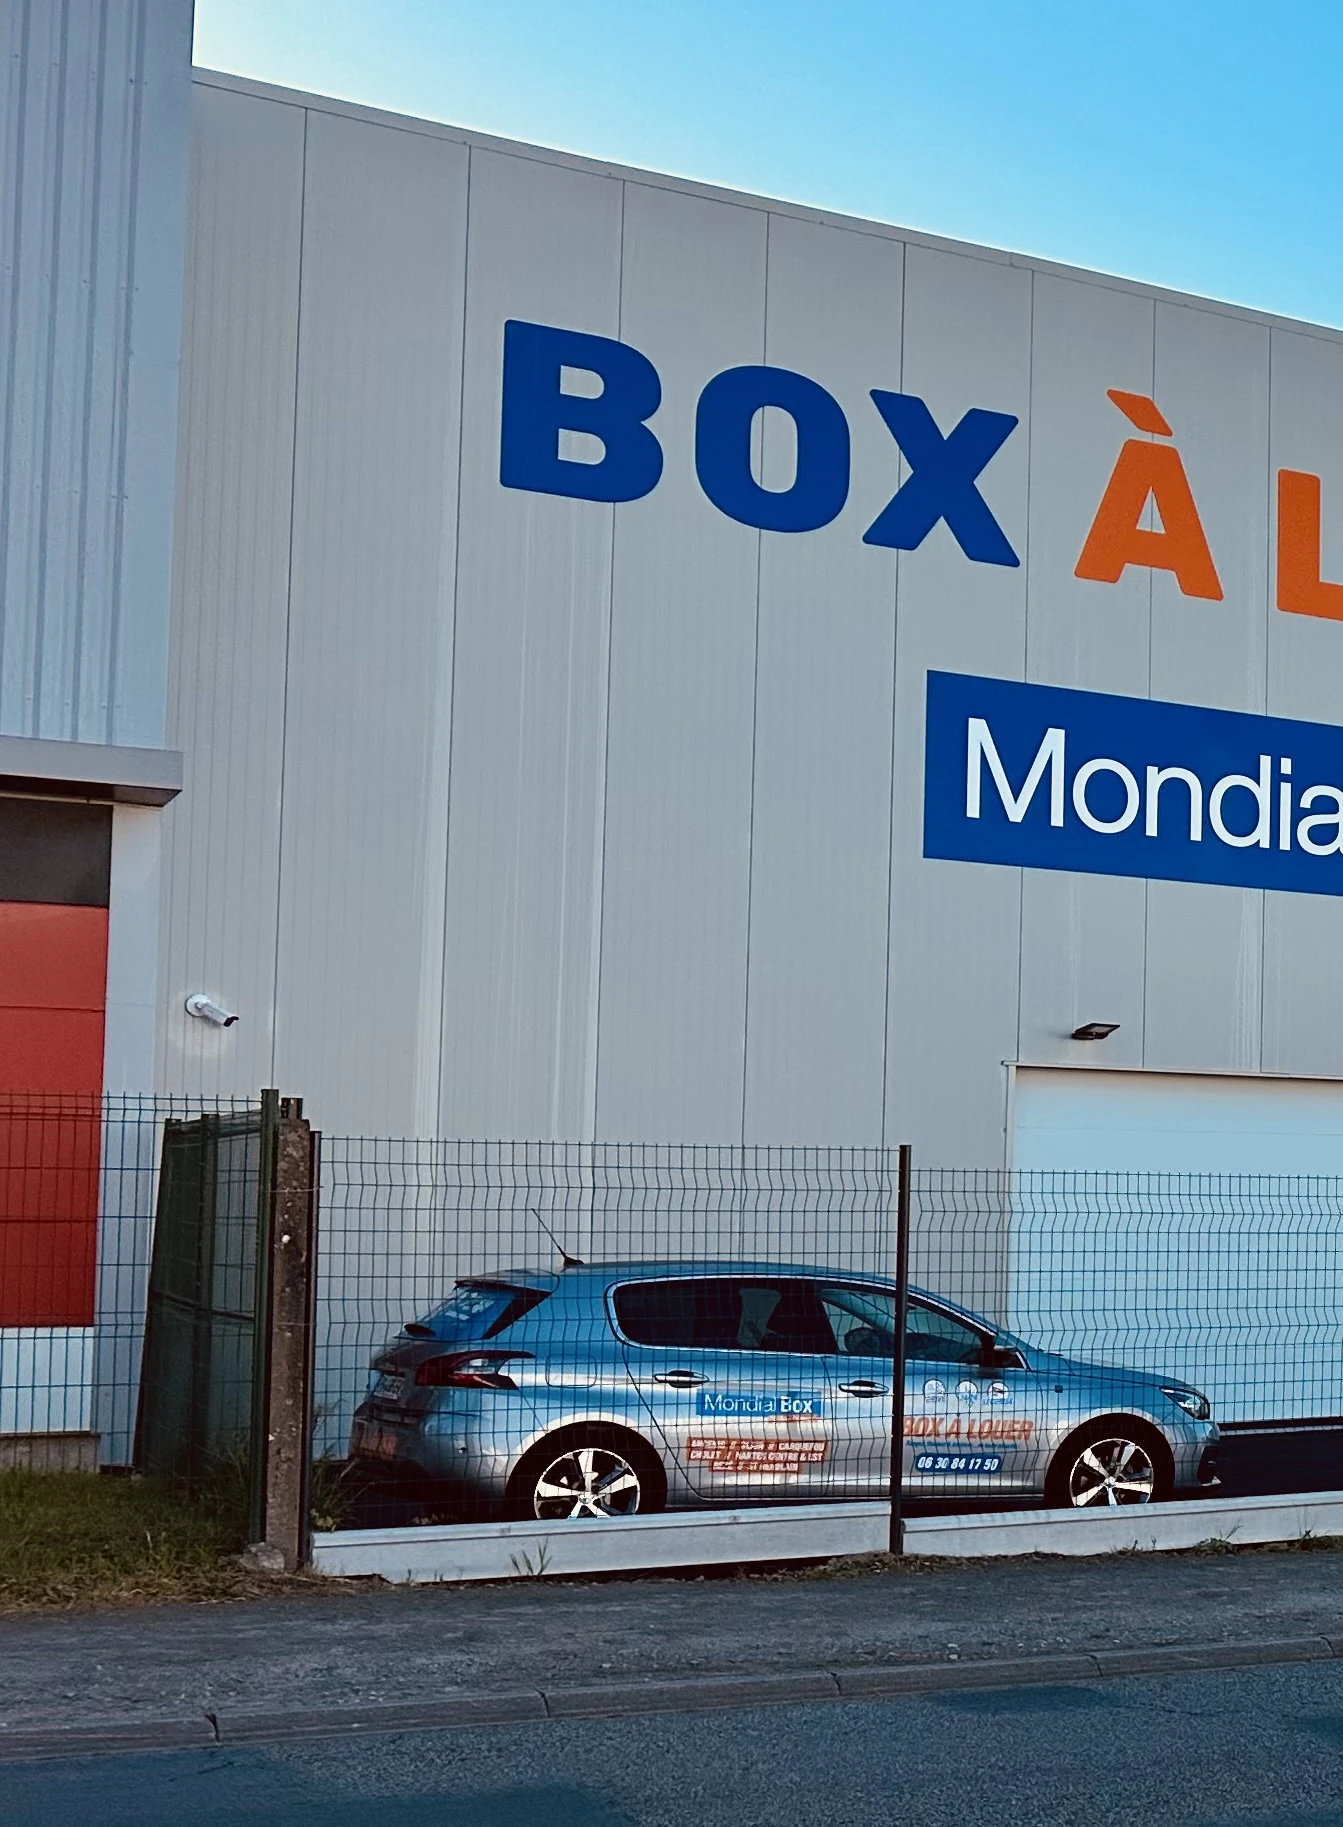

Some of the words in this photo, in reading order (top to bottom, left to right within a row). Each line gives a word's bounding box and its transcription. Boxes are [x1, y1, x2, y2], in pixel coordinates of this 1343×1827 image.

[500, 320, 1020, 568] BOX
[1075, 390, 1223, 600] À
[903, 1416, 945, 1438] BOX
[967, 1418, 1034, 1440] LOUER
[917, 1456, 934, 1468] 06
[935, 1457, 949, 1469] 30
[951, 1458, 966, 1469] 84
[968, 1458, 981, 1470] 17
[983, 1458, 999, 1471] 50
